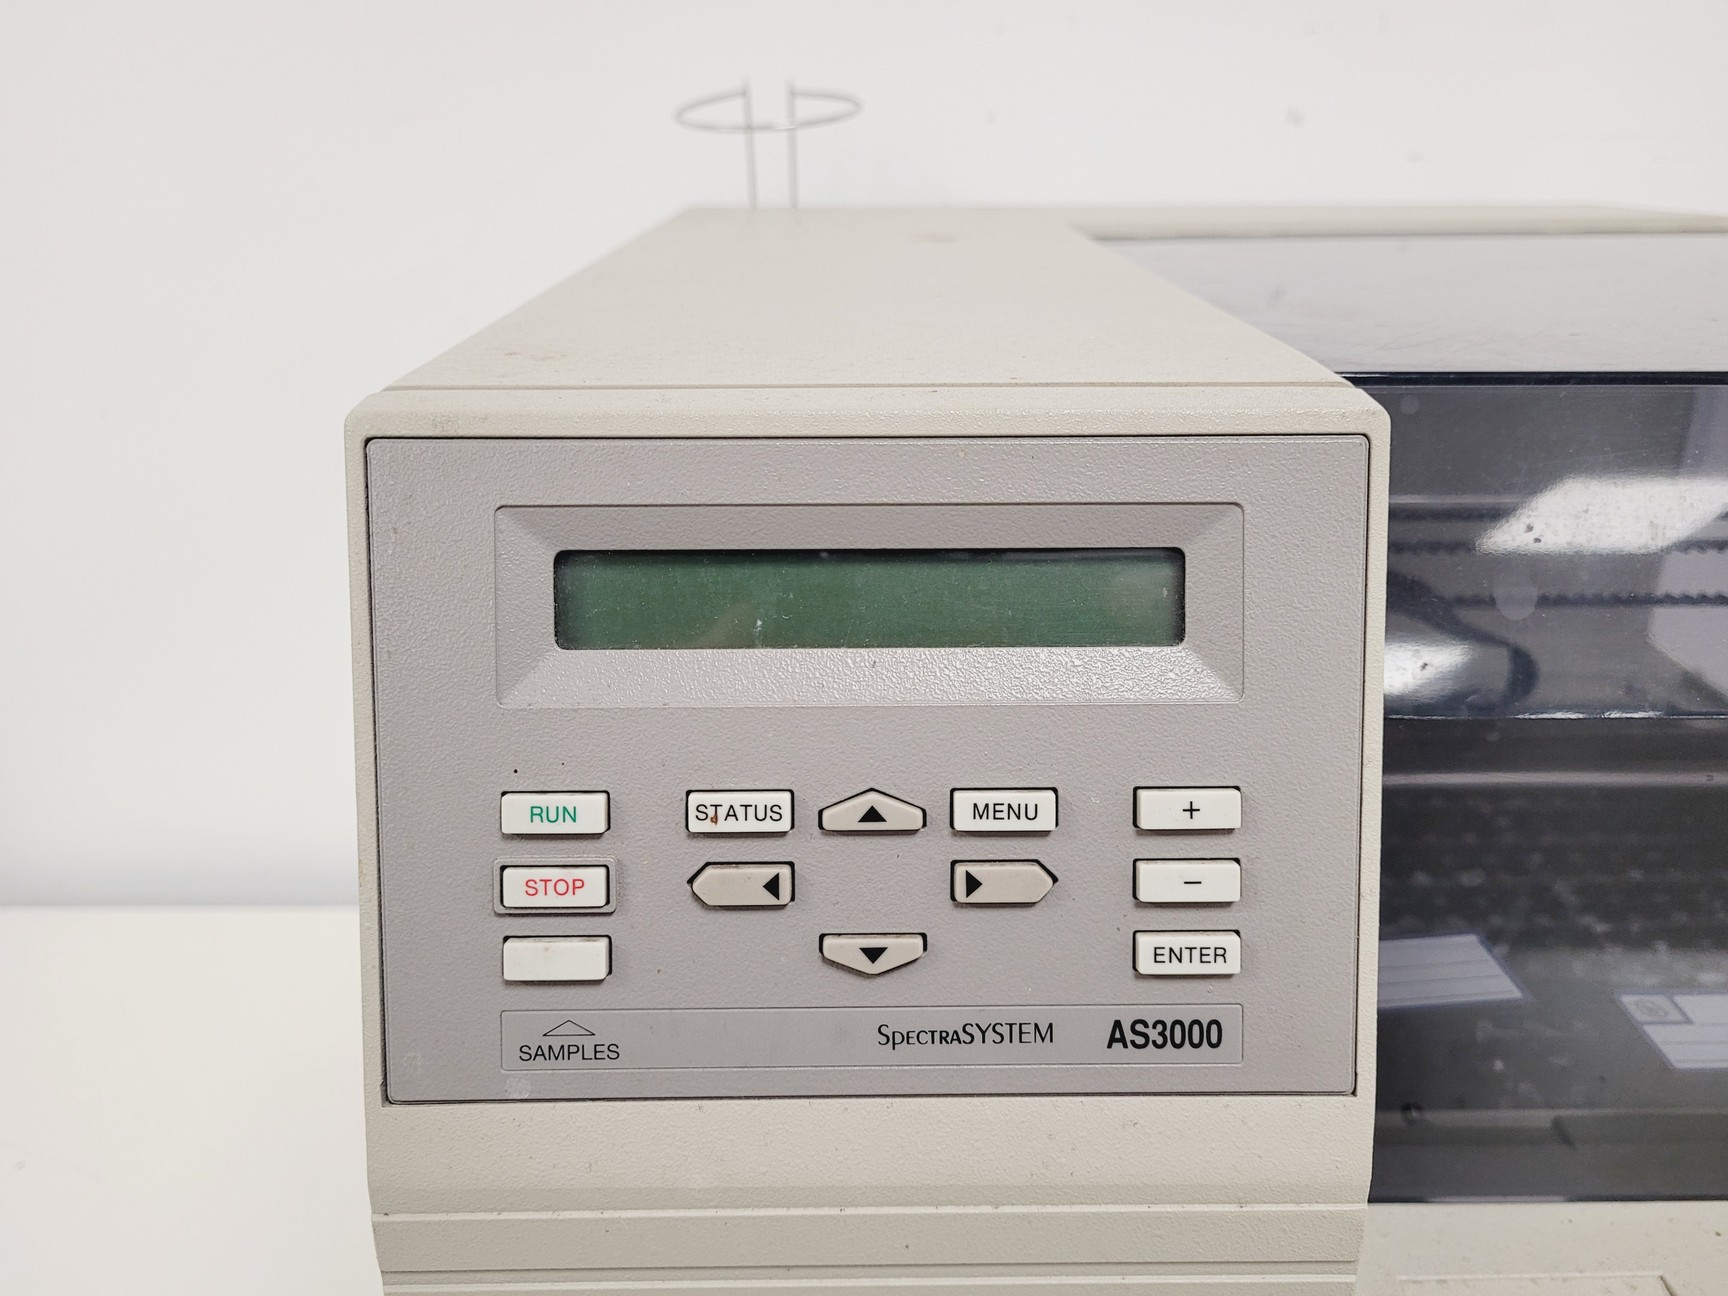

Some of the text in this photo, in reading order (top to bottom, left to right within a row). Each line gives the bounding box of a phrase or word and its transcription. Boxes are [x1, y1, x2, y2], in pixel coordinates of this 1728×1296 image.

[530, 805, 577, 824] RUN
[695, 803, 783, 823] STATUS
[972, 802, 1038, 821] MENU
[525, 878, 585, 897] STOP
[1153, 946, 1227, 964] ENTER
[1106, 1018, 1223, 1050] AS3000
[518, 1043, 620, 1062] SAMPLES
